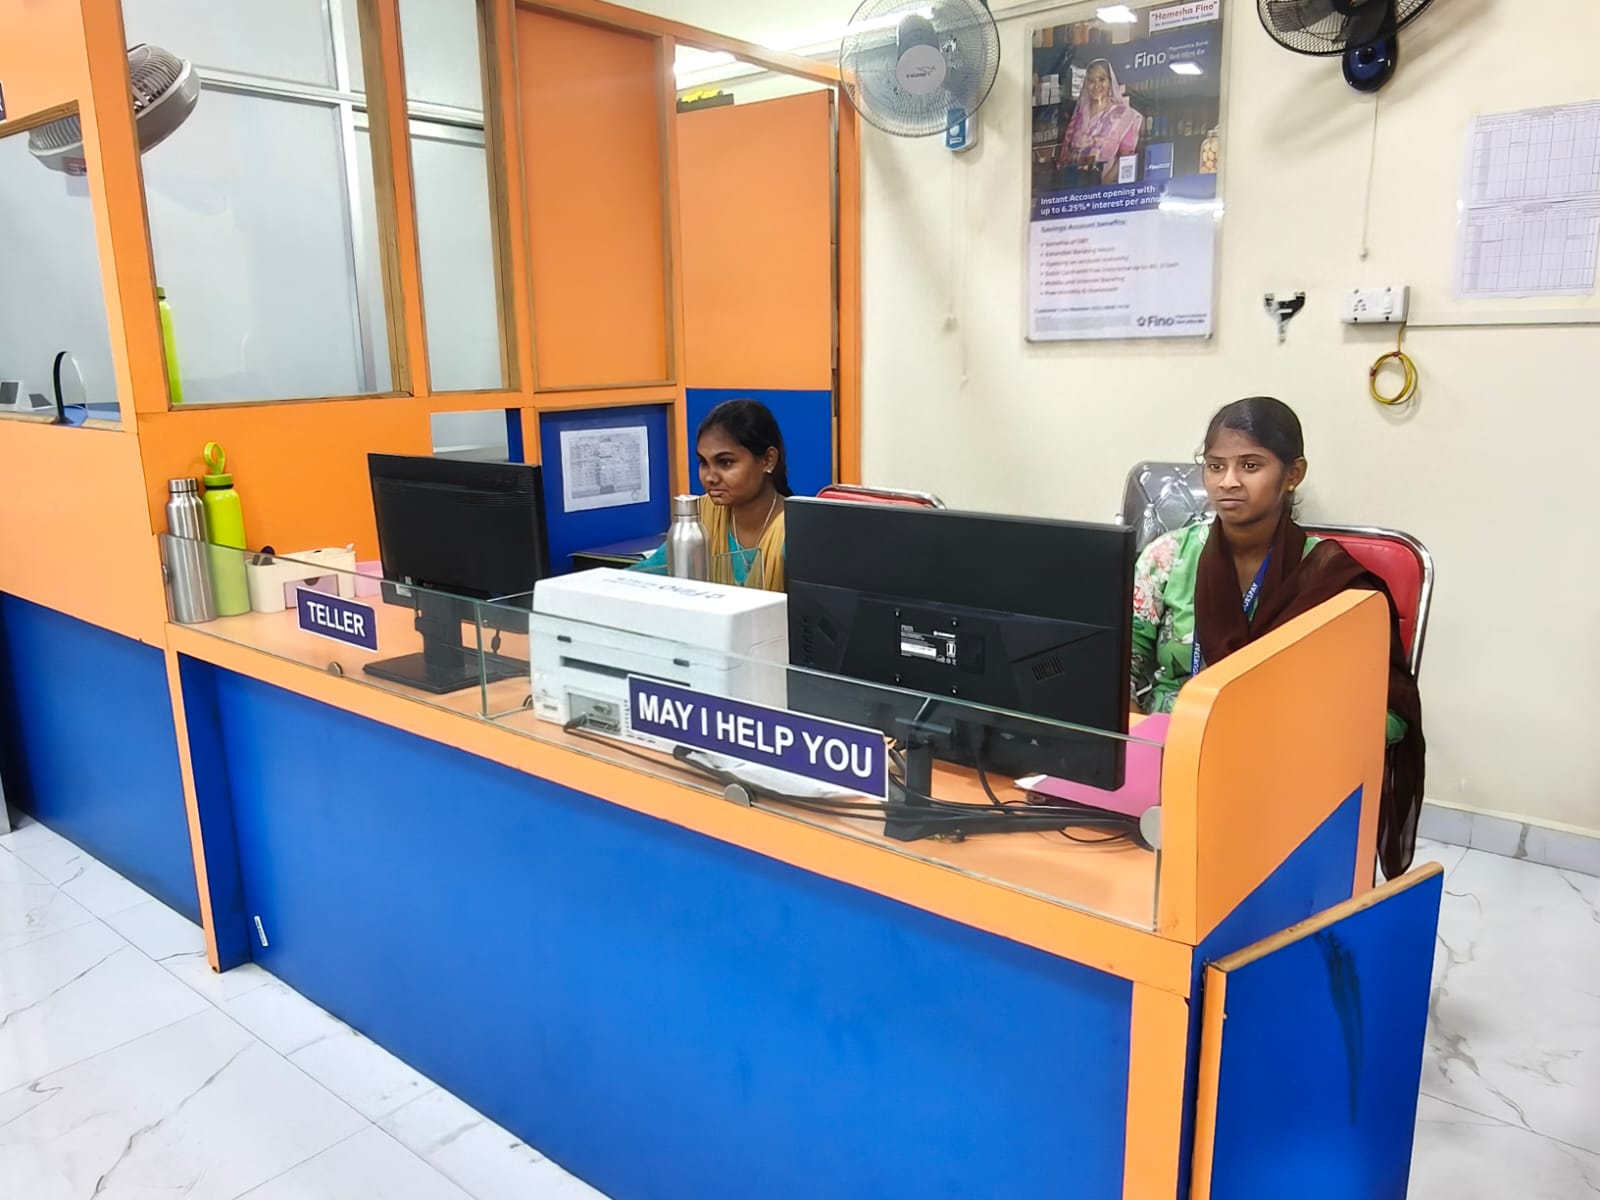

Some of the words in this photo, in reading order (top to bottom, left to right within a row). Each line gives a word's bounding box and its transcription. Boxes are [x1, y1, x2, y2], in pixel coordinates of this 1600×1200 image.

[1134, 52, 1167, 69] Fino
[1040, 196, 1068, 206] Instant
[1069, 191, 1102, 202] Account
[1102, 187, 1135, 200] opening
[1136, 185, 1156, 194] with
[1040, 208, 1051, 217] up
[1051, 206, 1061, 215] to
[1091, 199, 1124, 210] interest
[1125, 198, 1138, 208] per
[1147, 315, 1175, 328] Fino
[306, 600, 366, 638] TELLER
[638, 691, 694, 731] MAY
[700, 707, 708, 736] I
[716, 710, 794, 756] HELP
[801, 731, 873, 778] YOU
